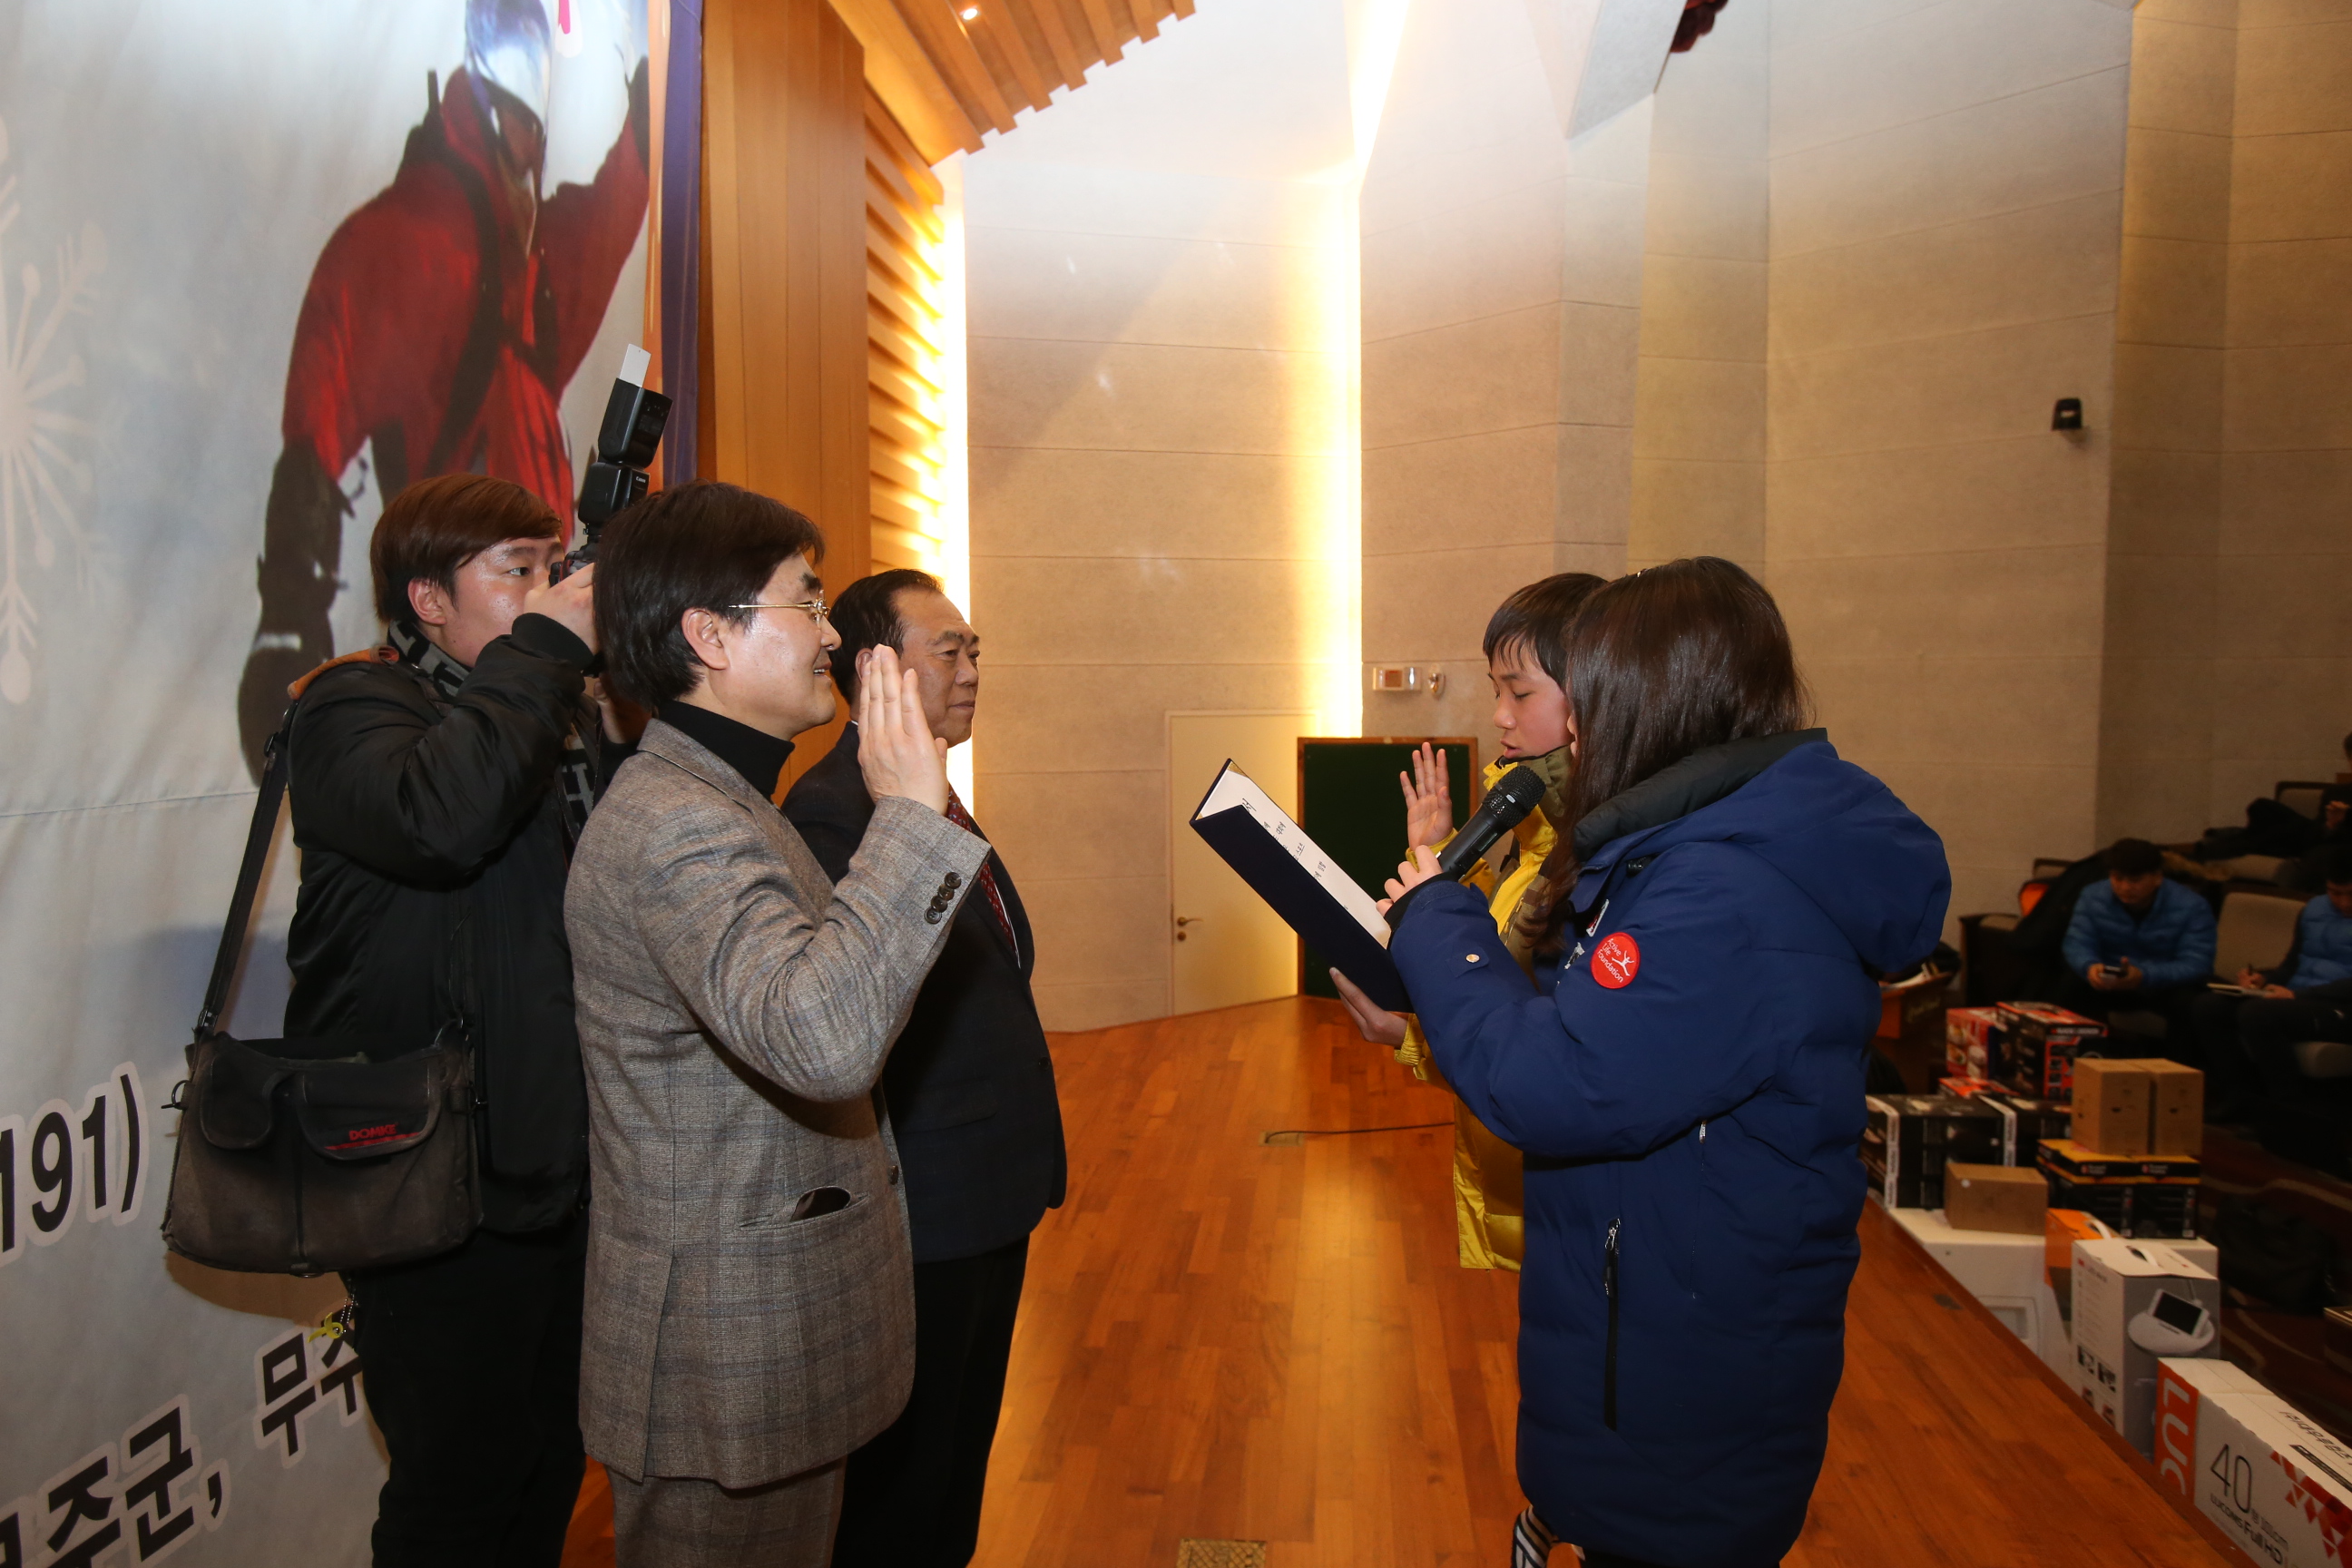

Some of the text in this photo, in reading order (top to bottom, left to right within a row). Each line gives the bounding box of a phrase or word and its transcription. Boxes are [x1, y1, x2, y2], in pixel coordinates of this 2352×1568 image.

[1602, 943, 1612, 956] Life
[1607, 938, 1622, 956] Active
[1597, 948, 1624, 983] Foundation
[348, 1123, 397, 1141] DOMKE
[2210, 1444, 2252, 1514] 40
